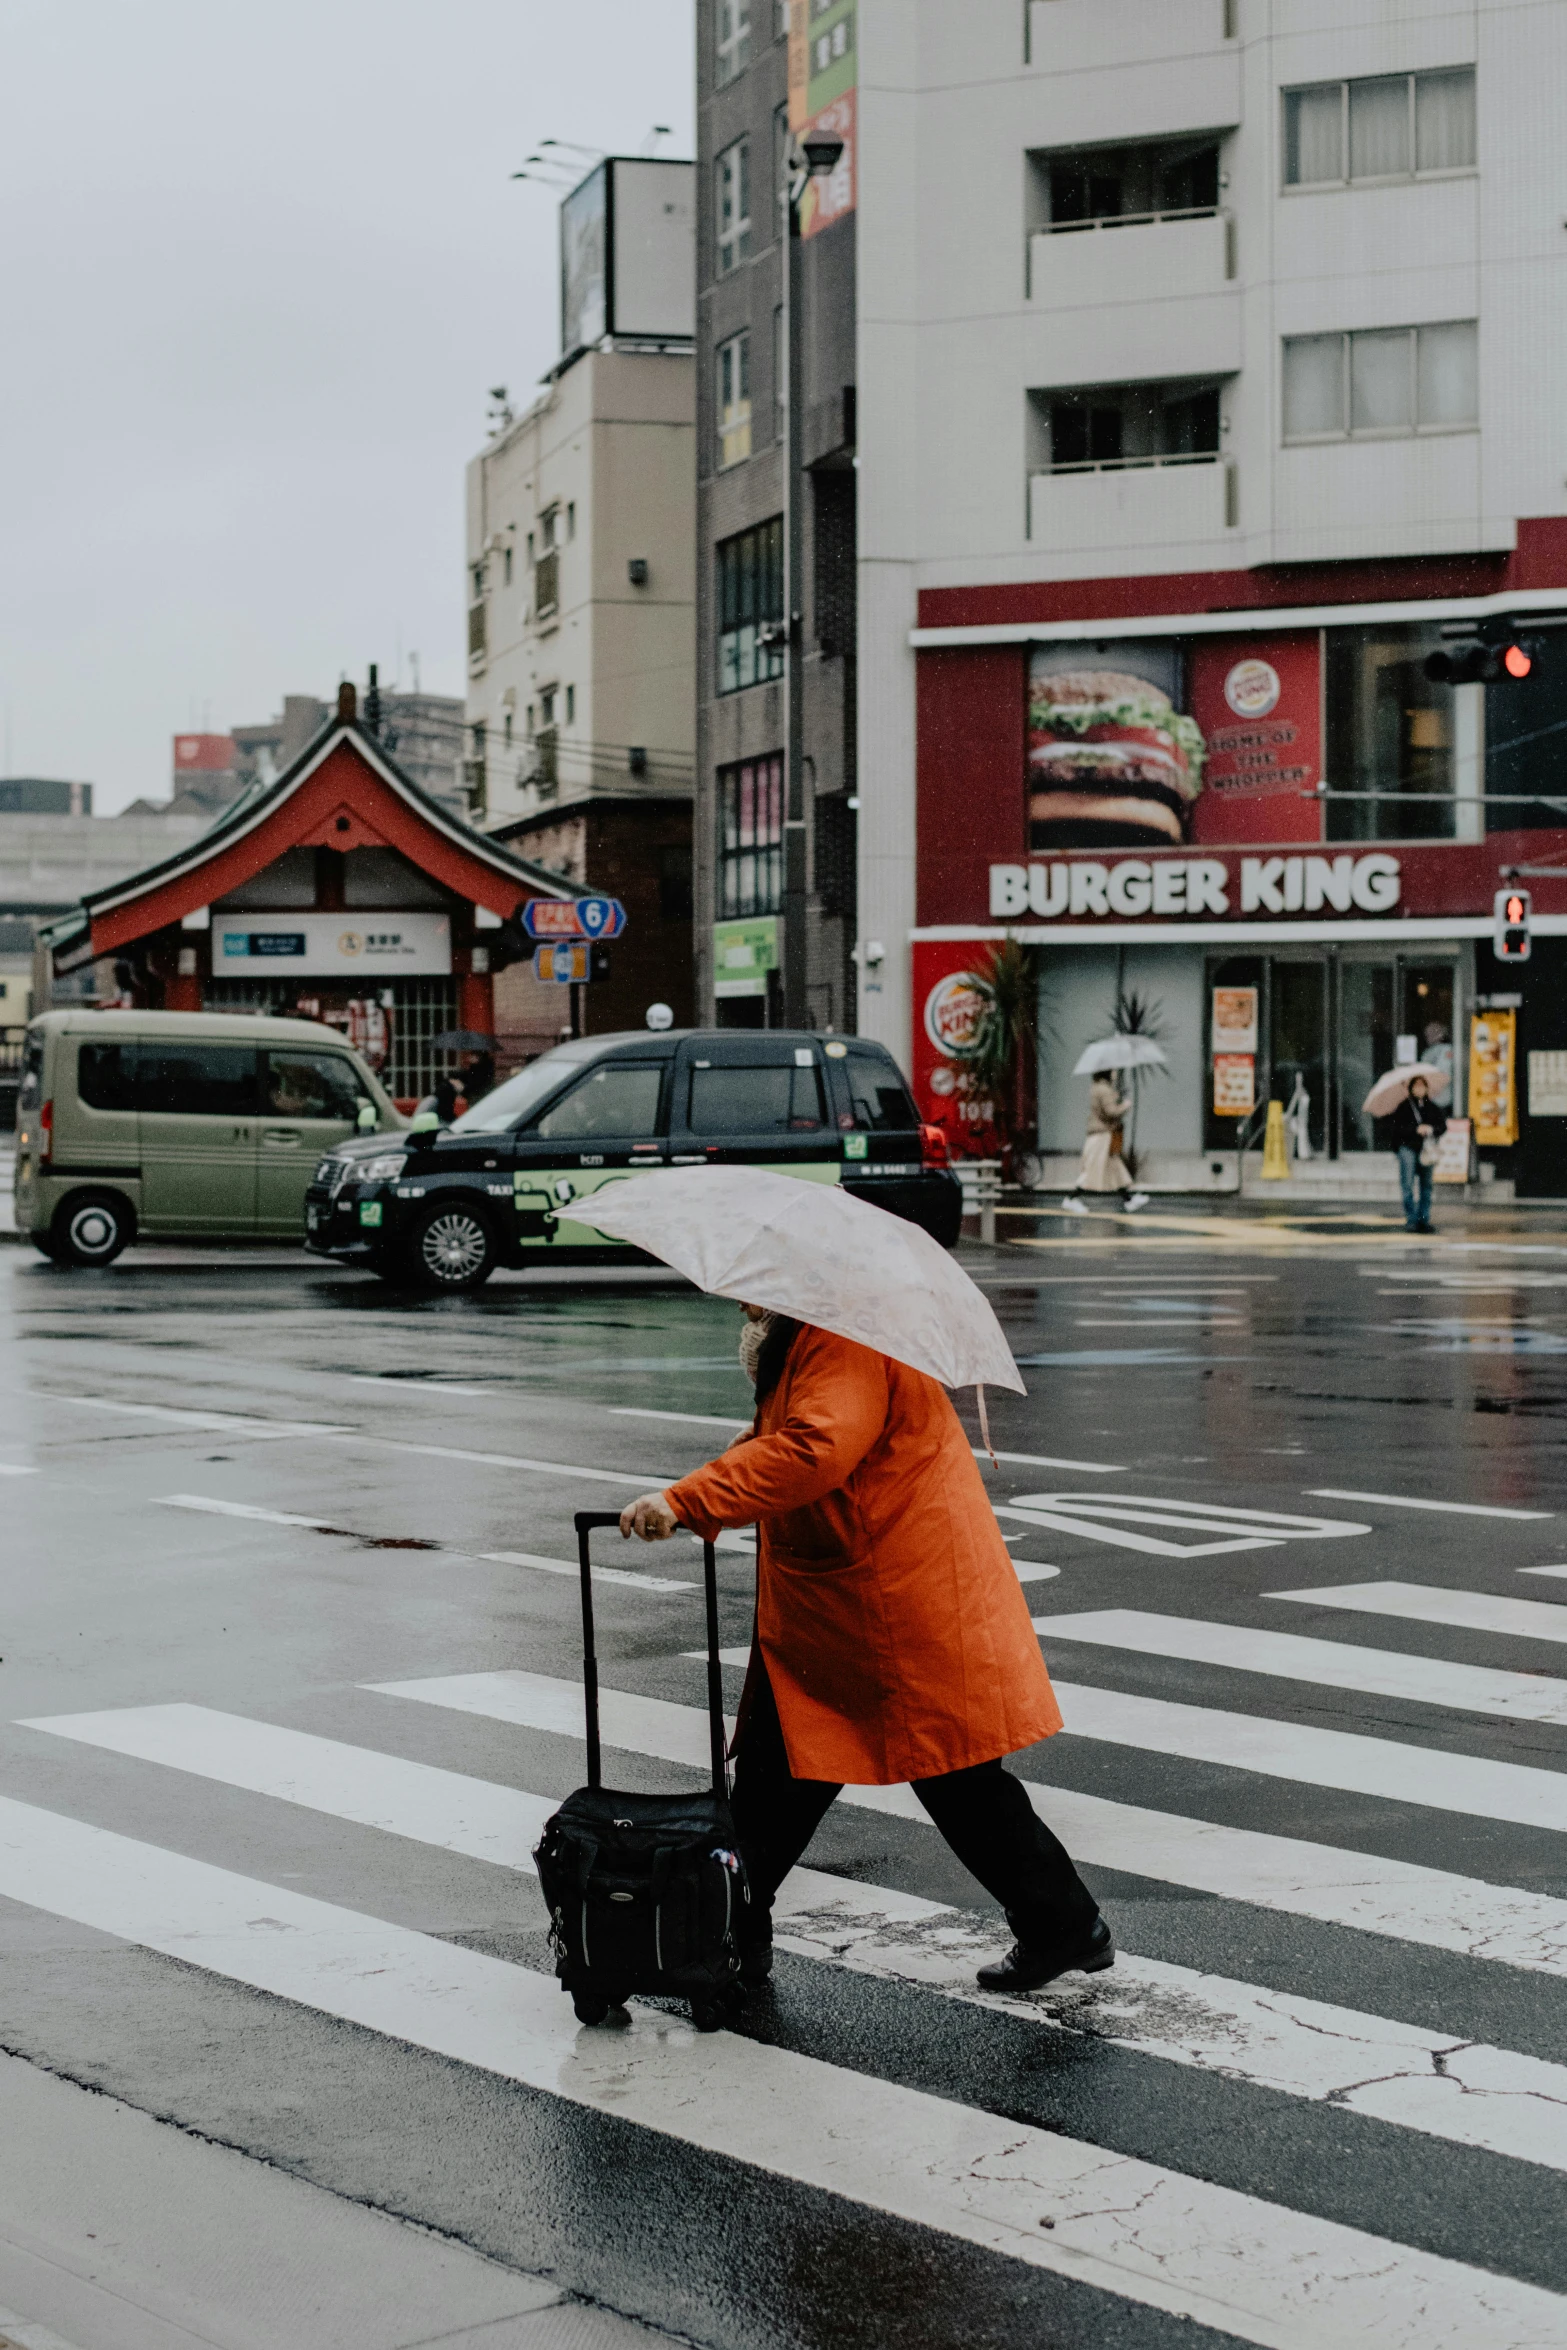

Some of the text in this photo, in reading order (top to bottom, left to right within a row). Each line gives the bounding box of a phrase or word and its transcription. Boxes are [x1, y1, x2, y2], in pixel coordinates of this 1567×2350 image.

[989, 853, 1400, 917] BURGER KING
[585, 902, 603, 928] 6
[940, 1012, 977, 1038] KIN
[487, 1184, 514, 1196] TAXI
